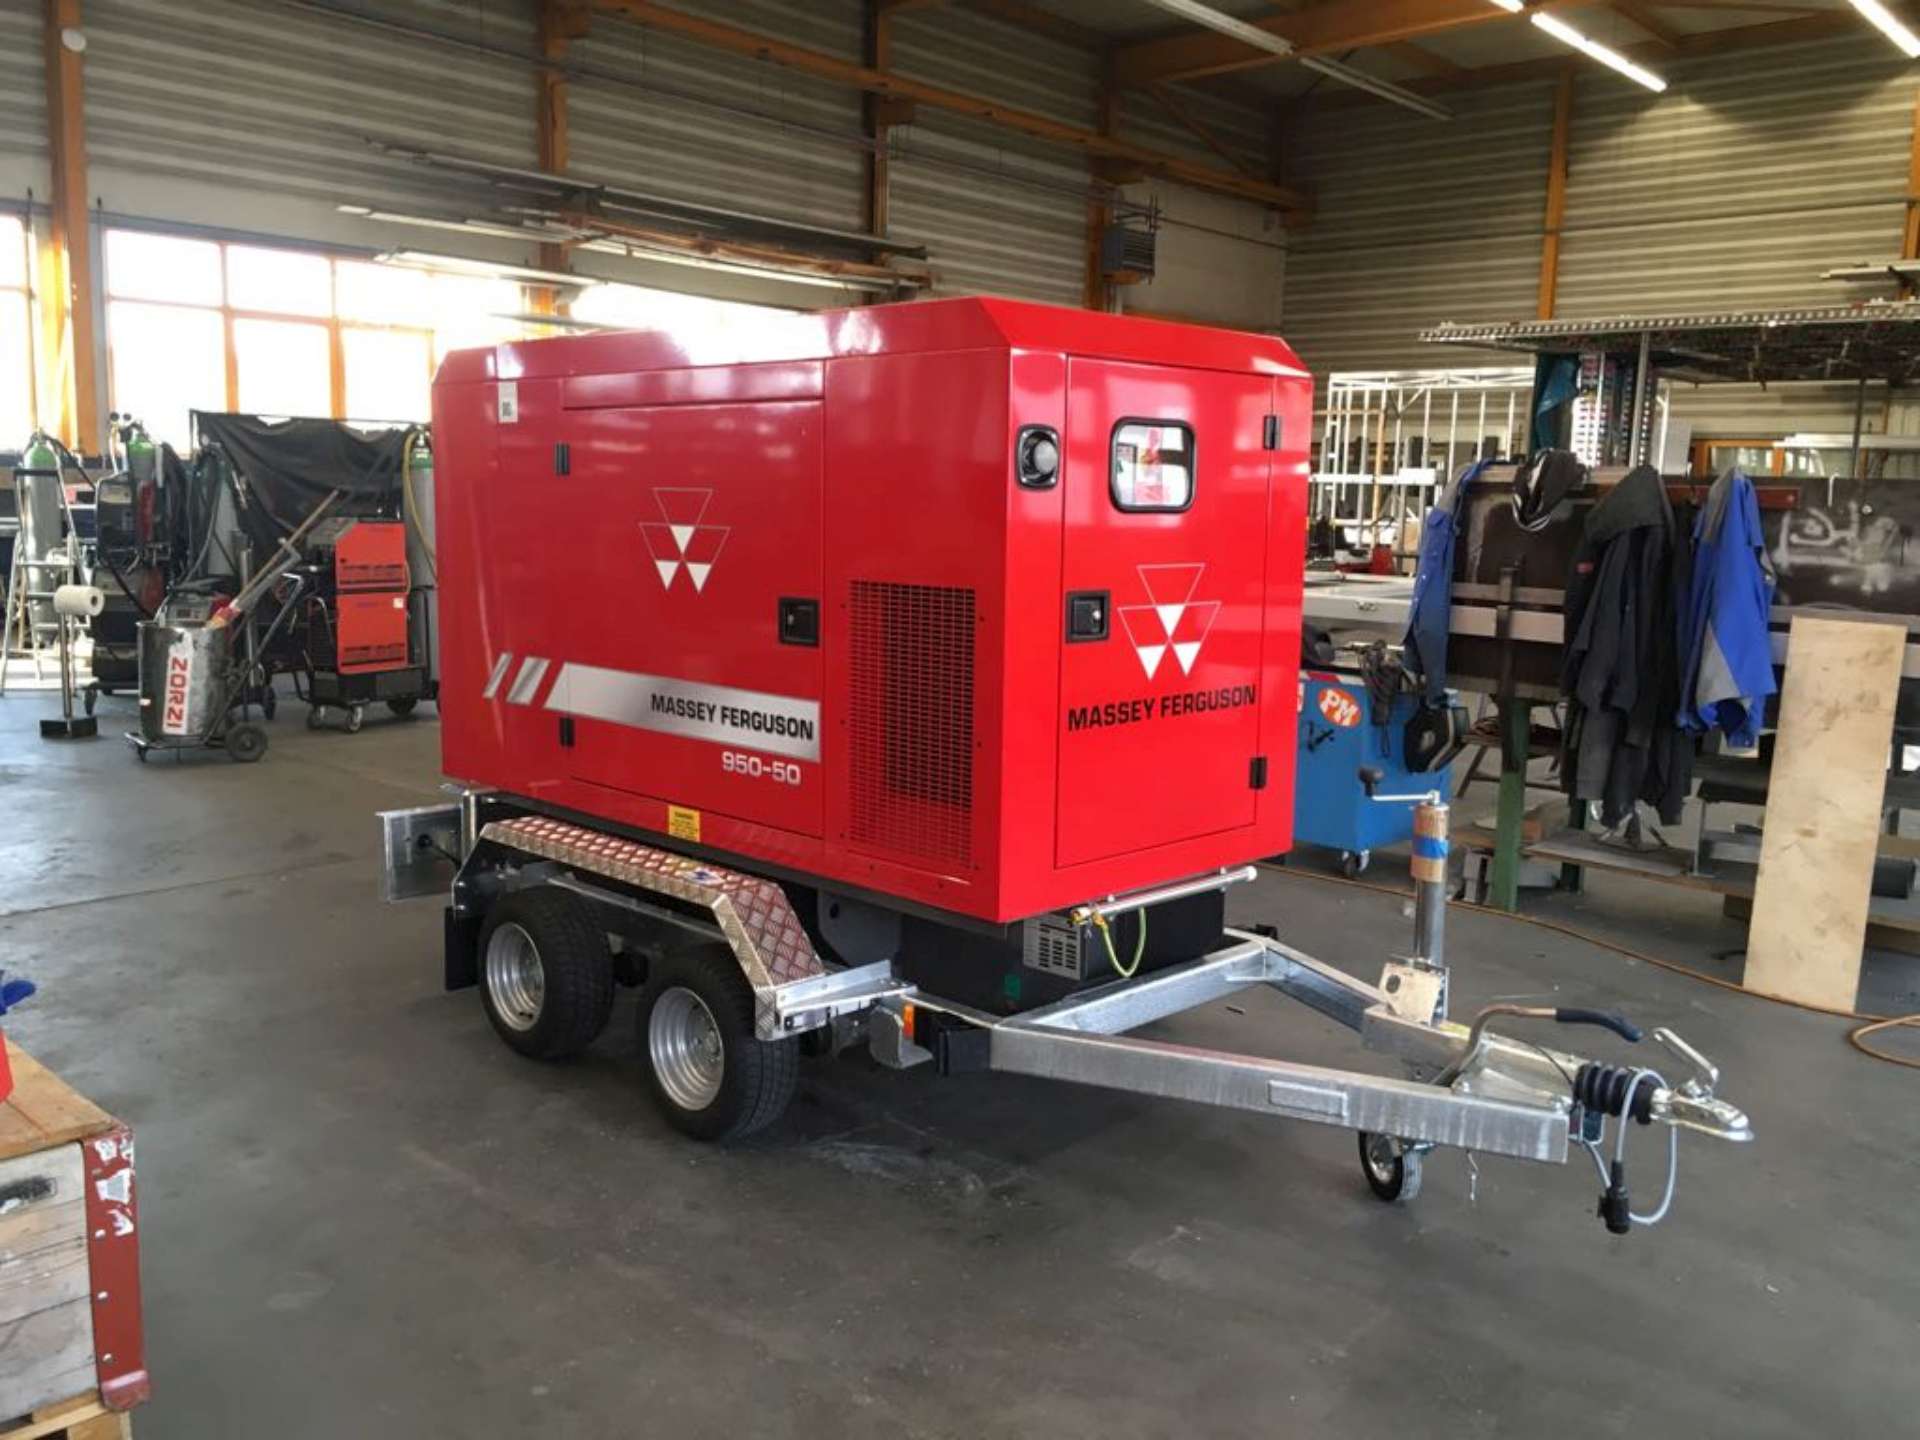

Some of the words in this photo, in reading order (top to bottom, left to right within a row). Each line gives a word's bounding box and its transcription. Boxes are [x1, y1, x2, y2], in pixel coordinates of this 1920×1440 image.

[651, 693, 717, 723] MASSEY
[720, 705, 814, 740] FERGUSON
[1067, 698, 1155, 732] MASSEY
[1160, 684, 1256, 718] FERGUSON
[1320, 689, 1359, 727] PM
[722, 751, 801, 785] 950-50
